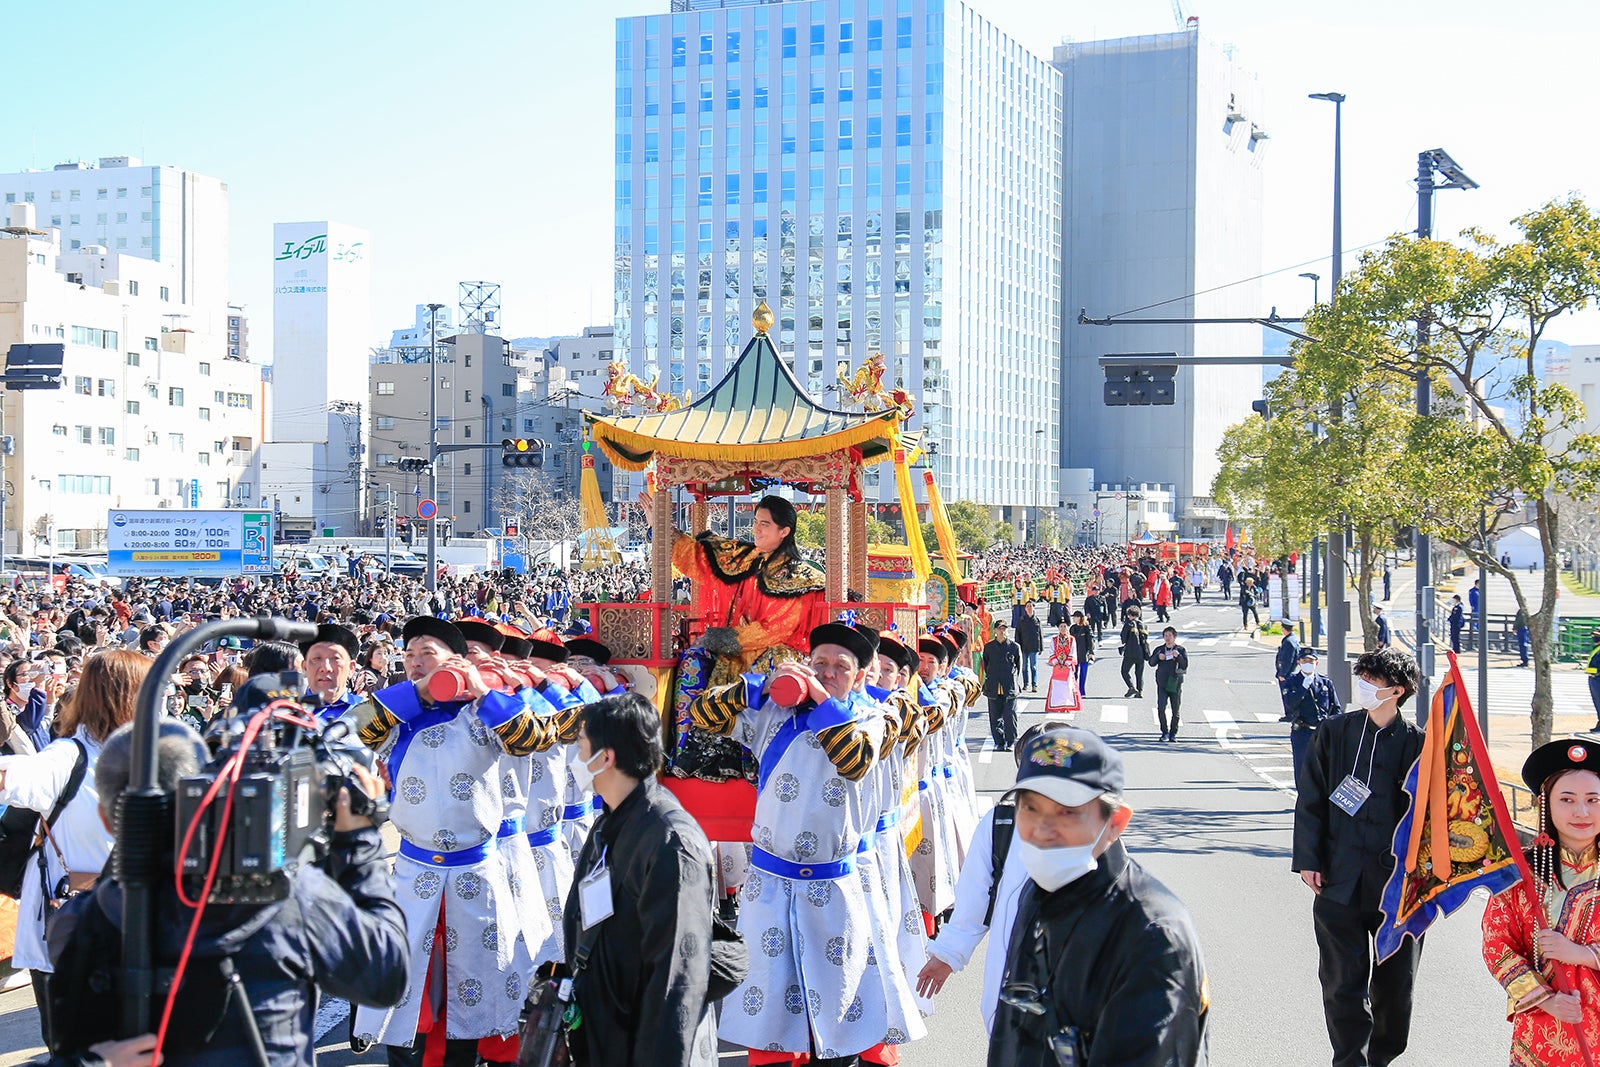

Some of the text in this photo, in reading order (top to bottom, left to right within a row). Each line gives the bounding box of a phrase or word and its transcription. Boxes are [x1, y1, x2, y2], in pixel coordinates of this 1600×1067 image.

[277, 236, 326, 260] エイブル
[246, 530, 257, 540] P
[191, 552, 216, 560] 1200円
[1334, 791, 1356, 808] STAFF
